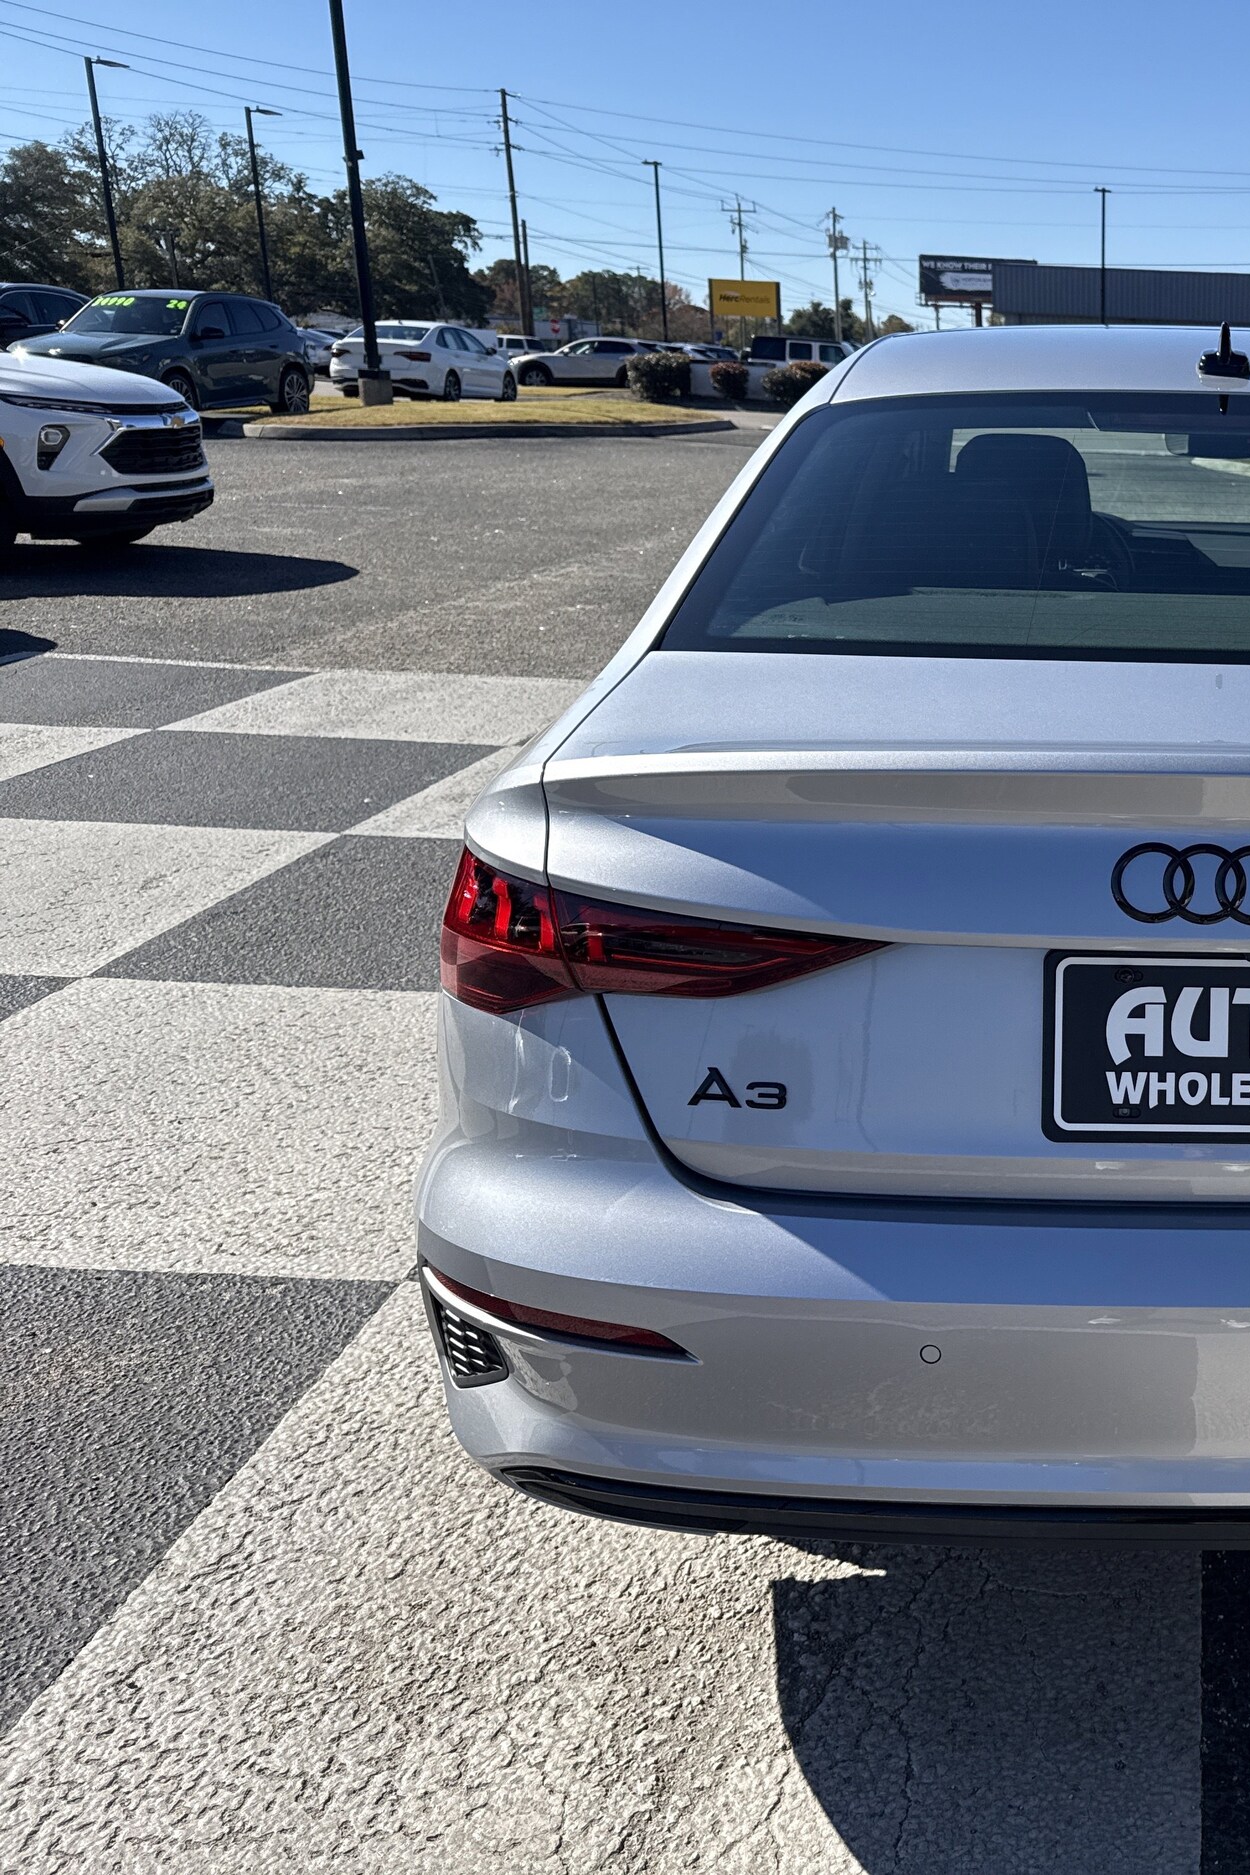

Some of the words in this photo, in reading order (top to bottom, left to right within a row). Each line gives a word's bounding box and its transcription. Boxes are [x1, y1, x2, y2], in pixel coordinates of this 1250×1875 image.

[922, 260, 936, 269] WE
[936, 261, 962, 270] KNOW
[963, 262, 988, 271] THEIR
[687, 1066, 788, 1110] A3
